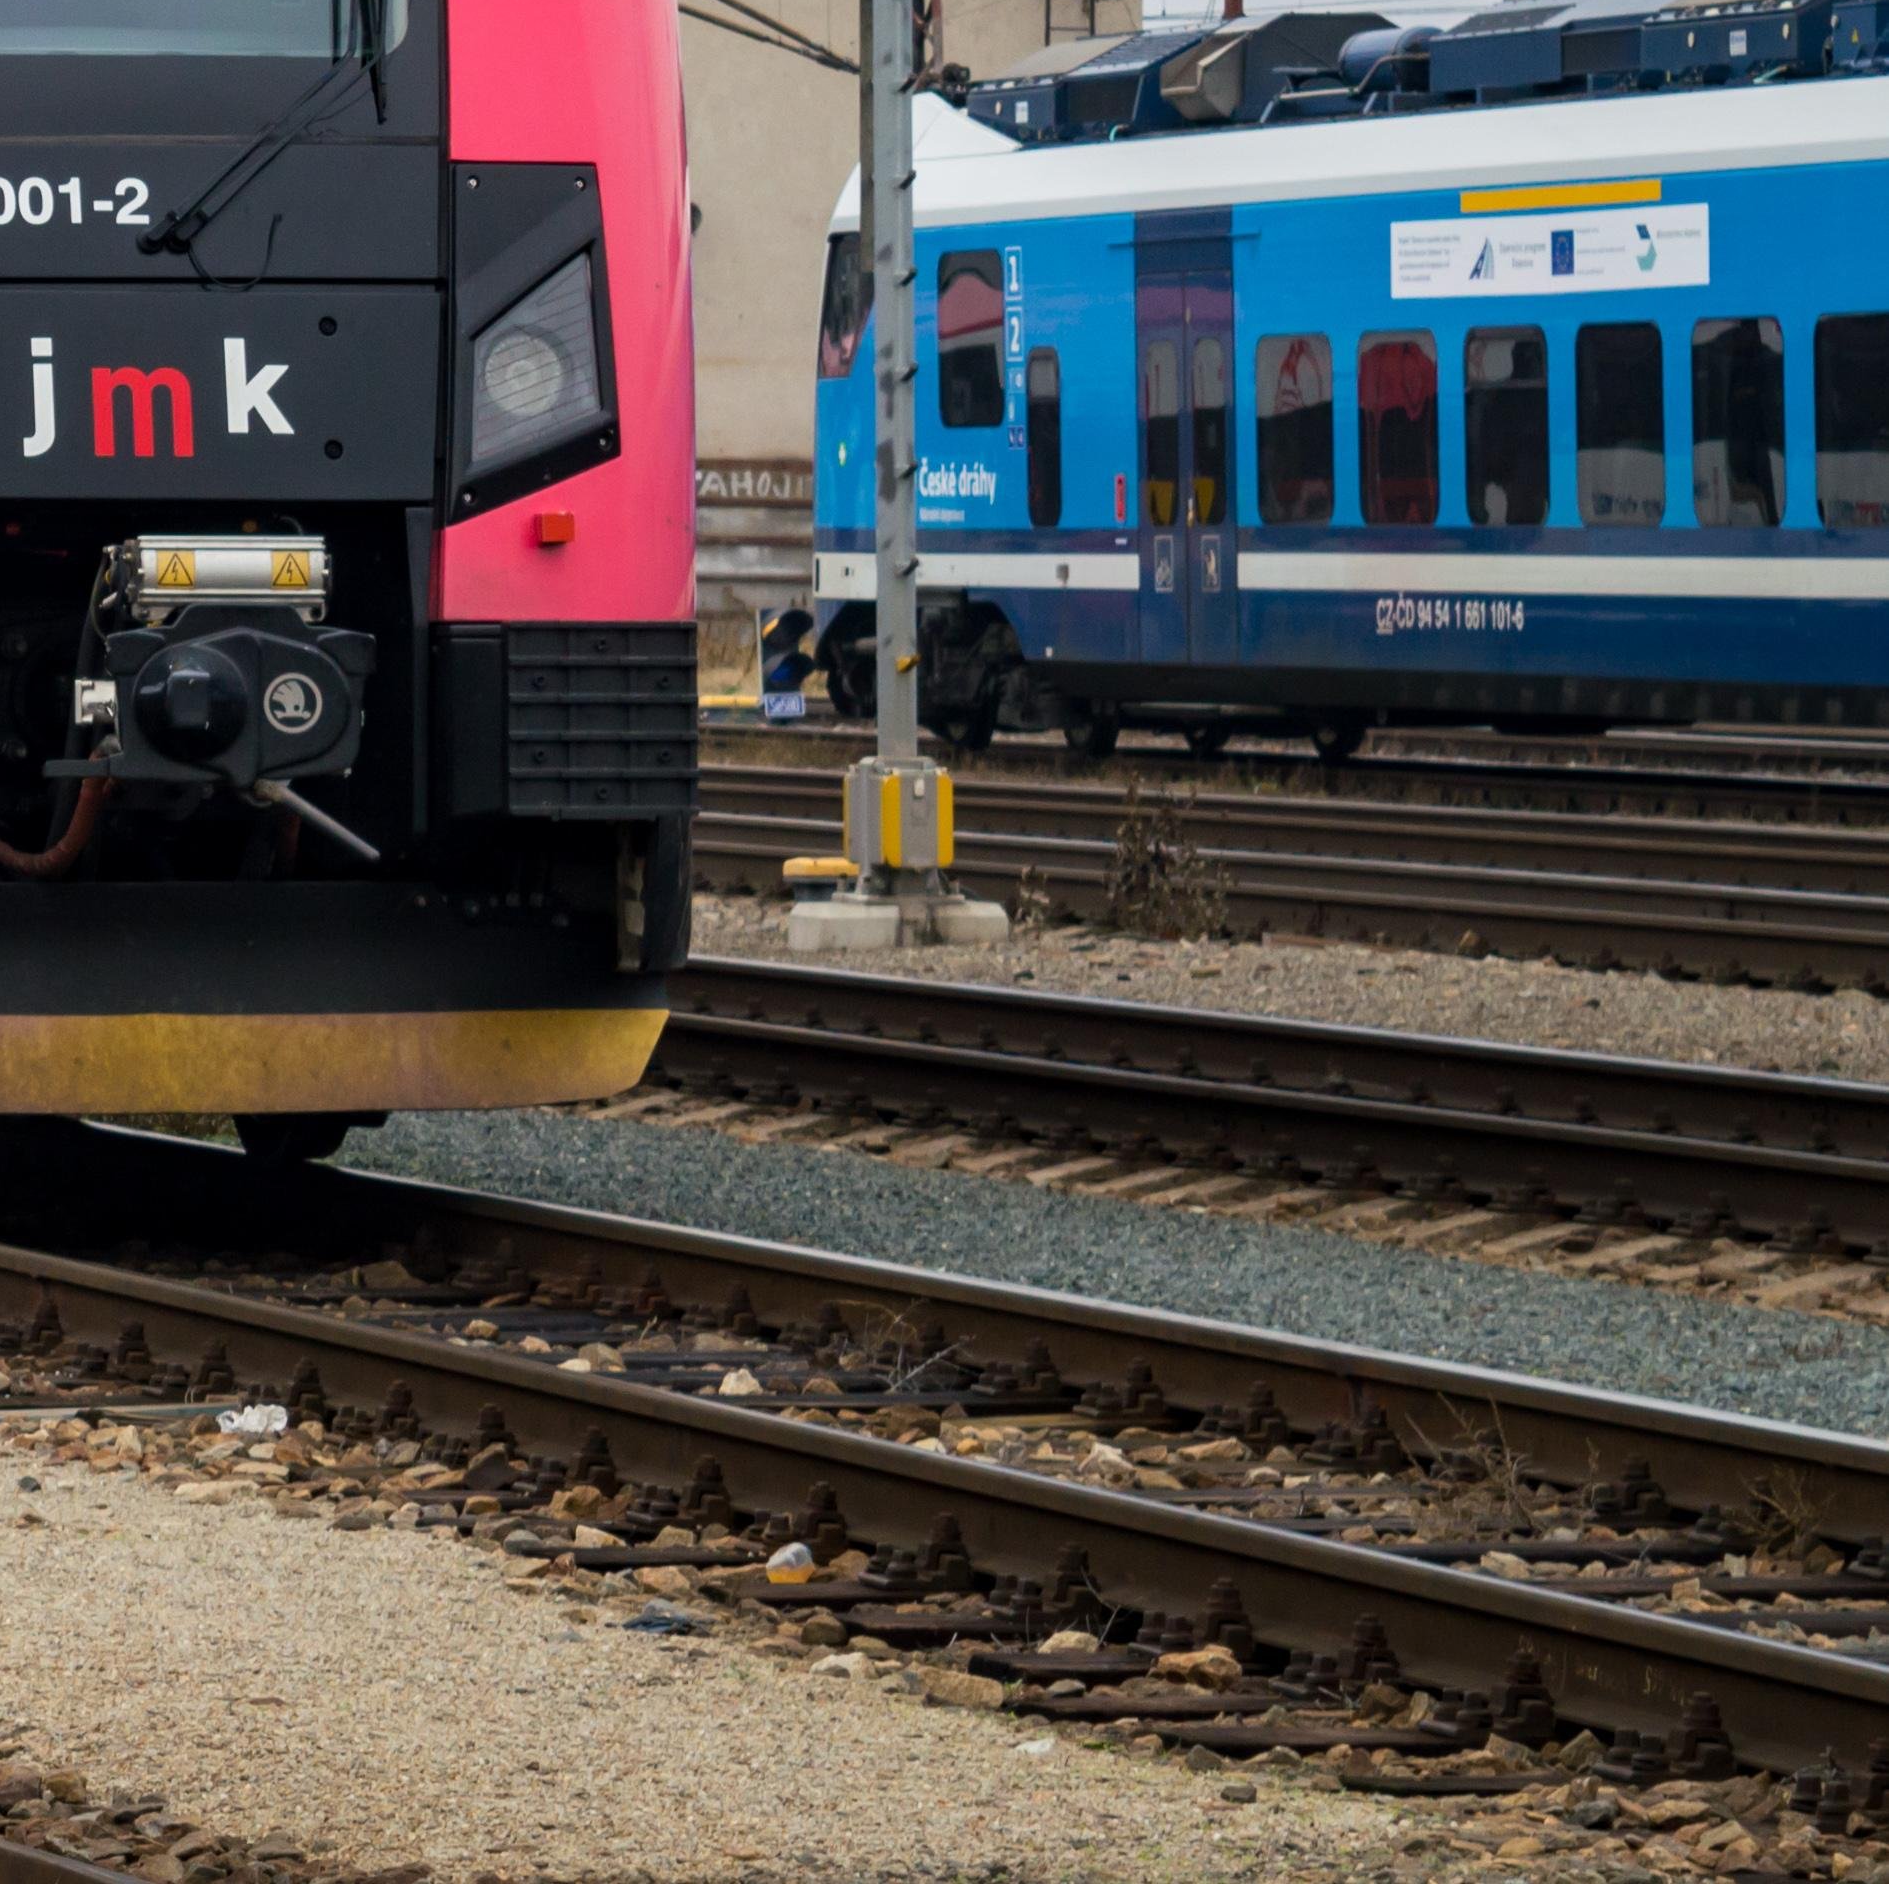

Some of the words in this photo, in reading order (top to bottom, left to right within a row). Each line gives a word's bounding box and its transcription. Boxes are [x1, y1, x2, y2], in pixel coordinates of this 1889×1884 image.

[1008, 255, 1019, 293] 1
[1010, 316, 1020, 352] 2
[23, 337, 295, 458] jmk
[919, 457, 957, 497] České
[958, 462, 997, 506] dráhy
[1376, 592, 1415, 633] CZ-ČD
[1417, 599, 1432, 630] 94
[1435, 599, 1450, 630] 54
[1465, 600, 1486, 631] 661
